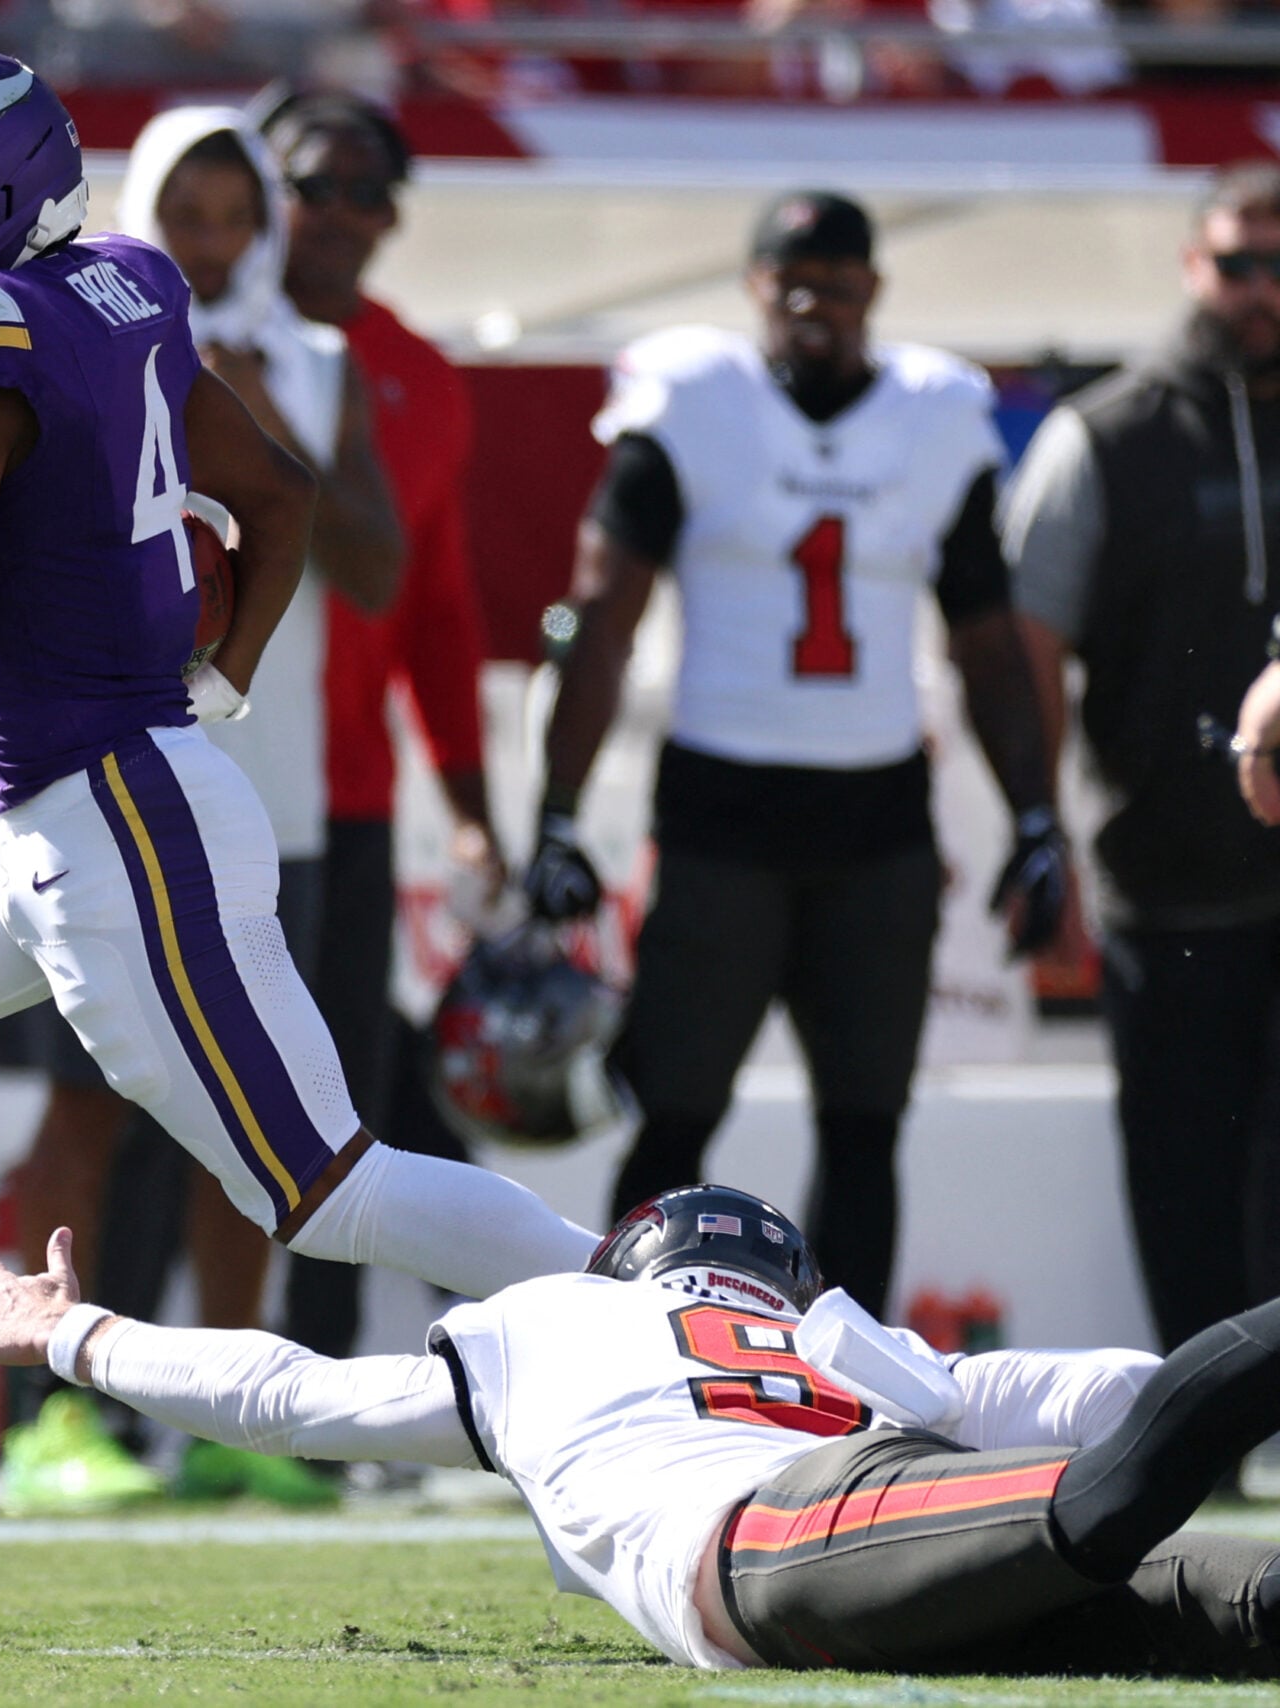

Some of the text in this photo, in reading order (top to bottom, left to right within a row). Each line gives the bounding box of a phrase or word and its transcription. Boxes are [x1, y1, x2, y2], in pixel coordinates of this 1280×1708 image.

[65, 262, 162, 326] PRICE
[132, 343, 196, 594] 4
[788, 514, 858, 682] 1
[708, 1272, 785, 1311] BUCCANEERS
[667, 1302, 872, 1437] 9
